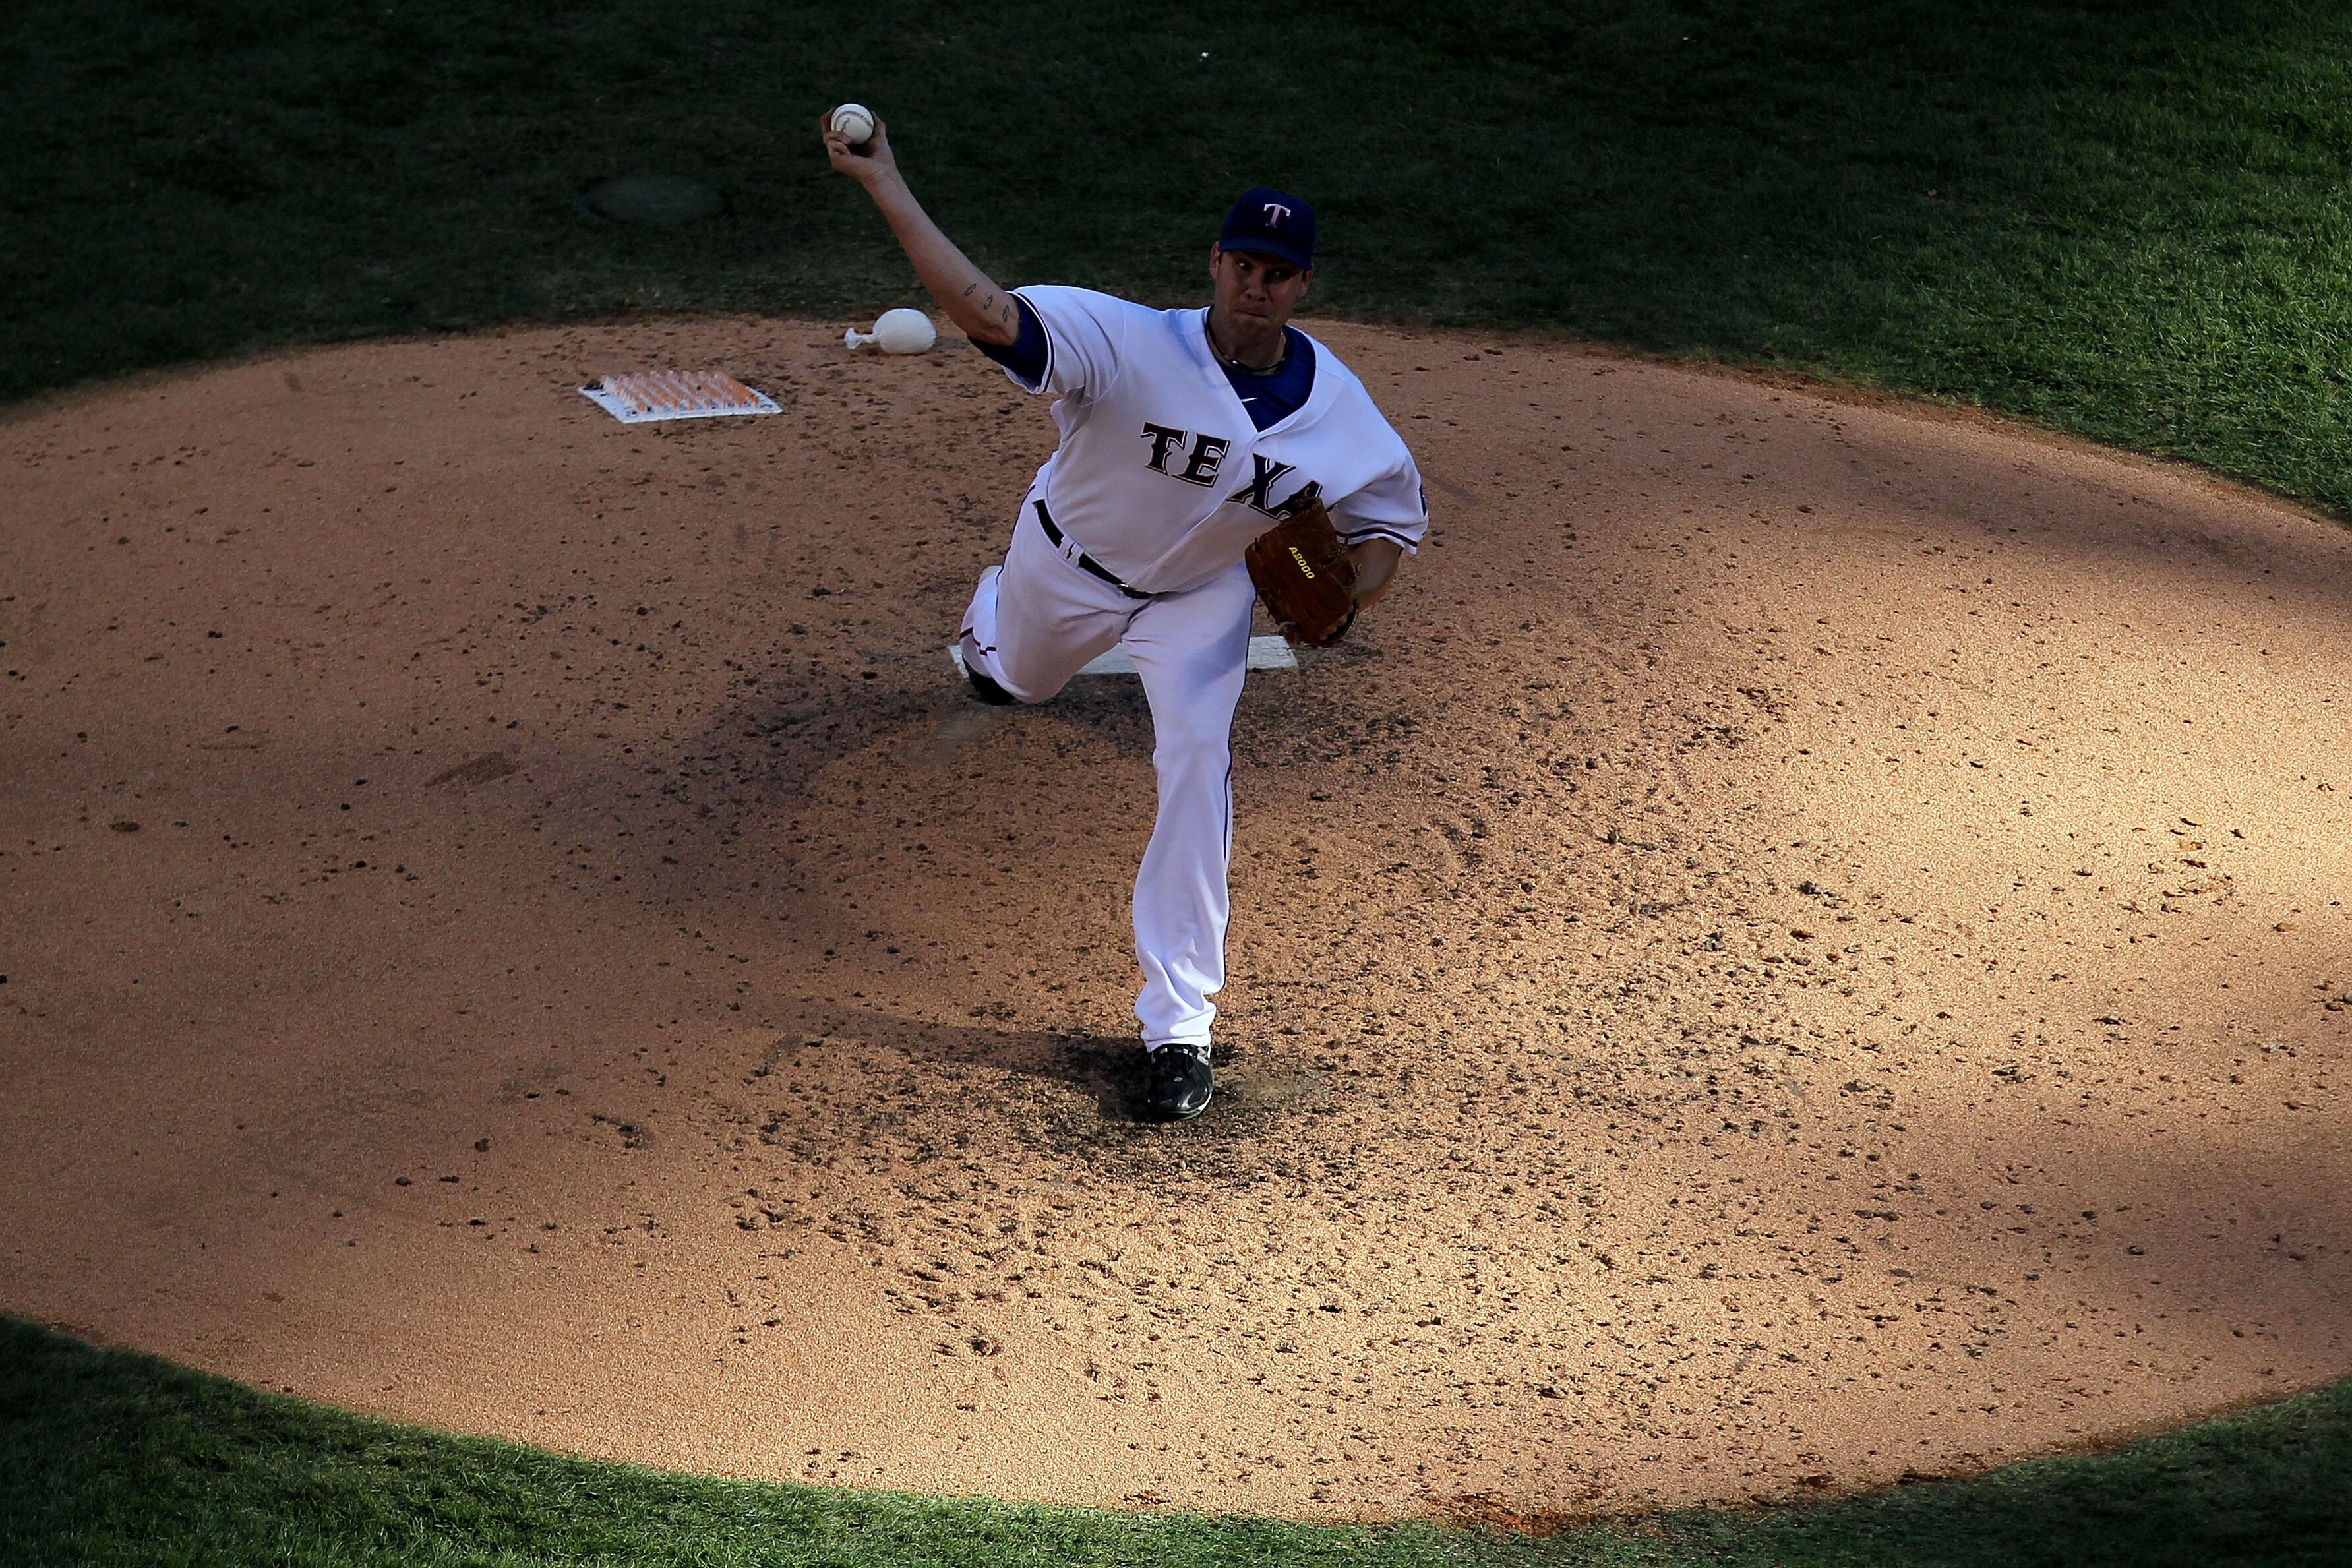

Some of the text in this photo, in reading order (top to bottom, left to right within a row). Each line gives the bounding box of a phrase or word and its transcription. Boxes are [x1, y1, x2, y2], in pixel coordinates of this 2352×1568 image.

[1263, 203, 1292, 229] T
[1140, 421, 1324, 521] TEXA
[1288, 547, 1315, 579] A2000
